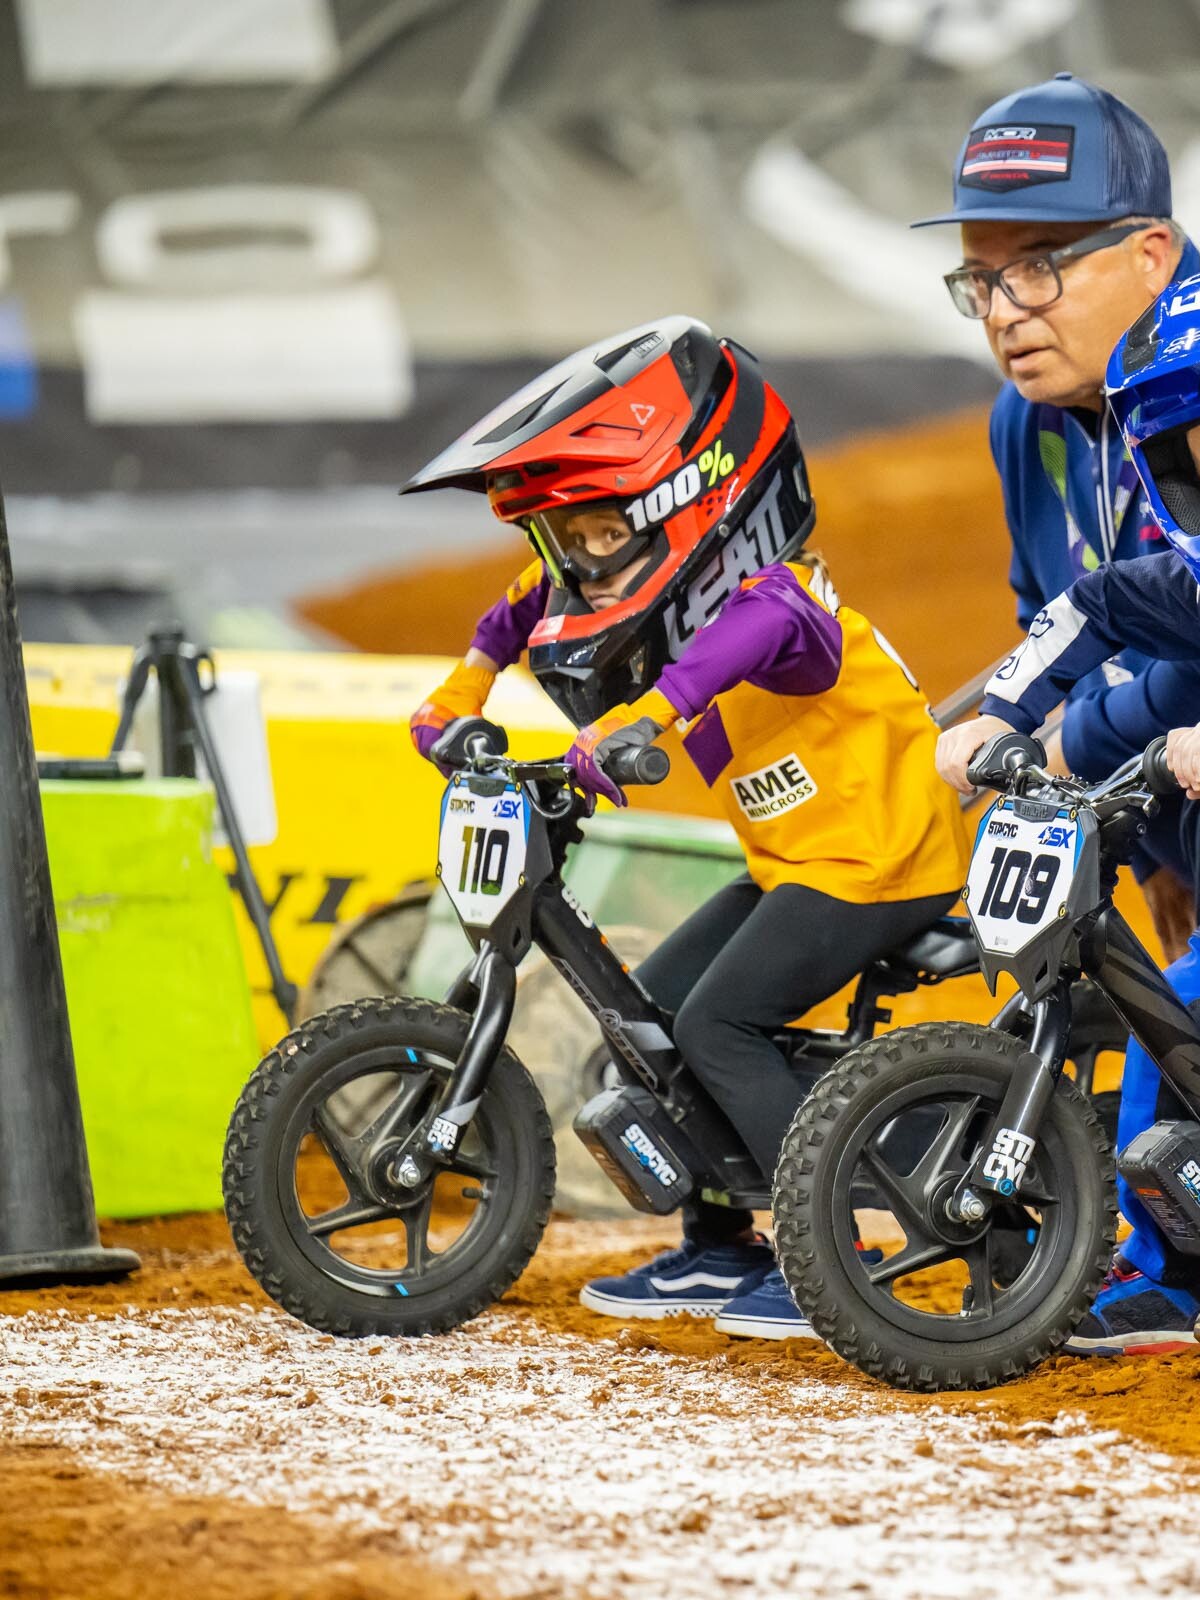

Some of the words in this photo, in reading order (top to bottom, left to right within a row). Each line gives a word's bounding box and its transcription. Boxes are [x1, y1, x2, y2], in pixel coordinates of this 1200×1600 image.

[625, 439, 735, 532] 100%
[734, 759, 807, 807] AME
[747, 783, 813, 818] MINICROSS
[458, 825, 510, 896] 110
[988, 820, 1018, 838] STACYC
[978, 846, 1061, 925] 109
[625, 1123, 677, 1186] STACYC
